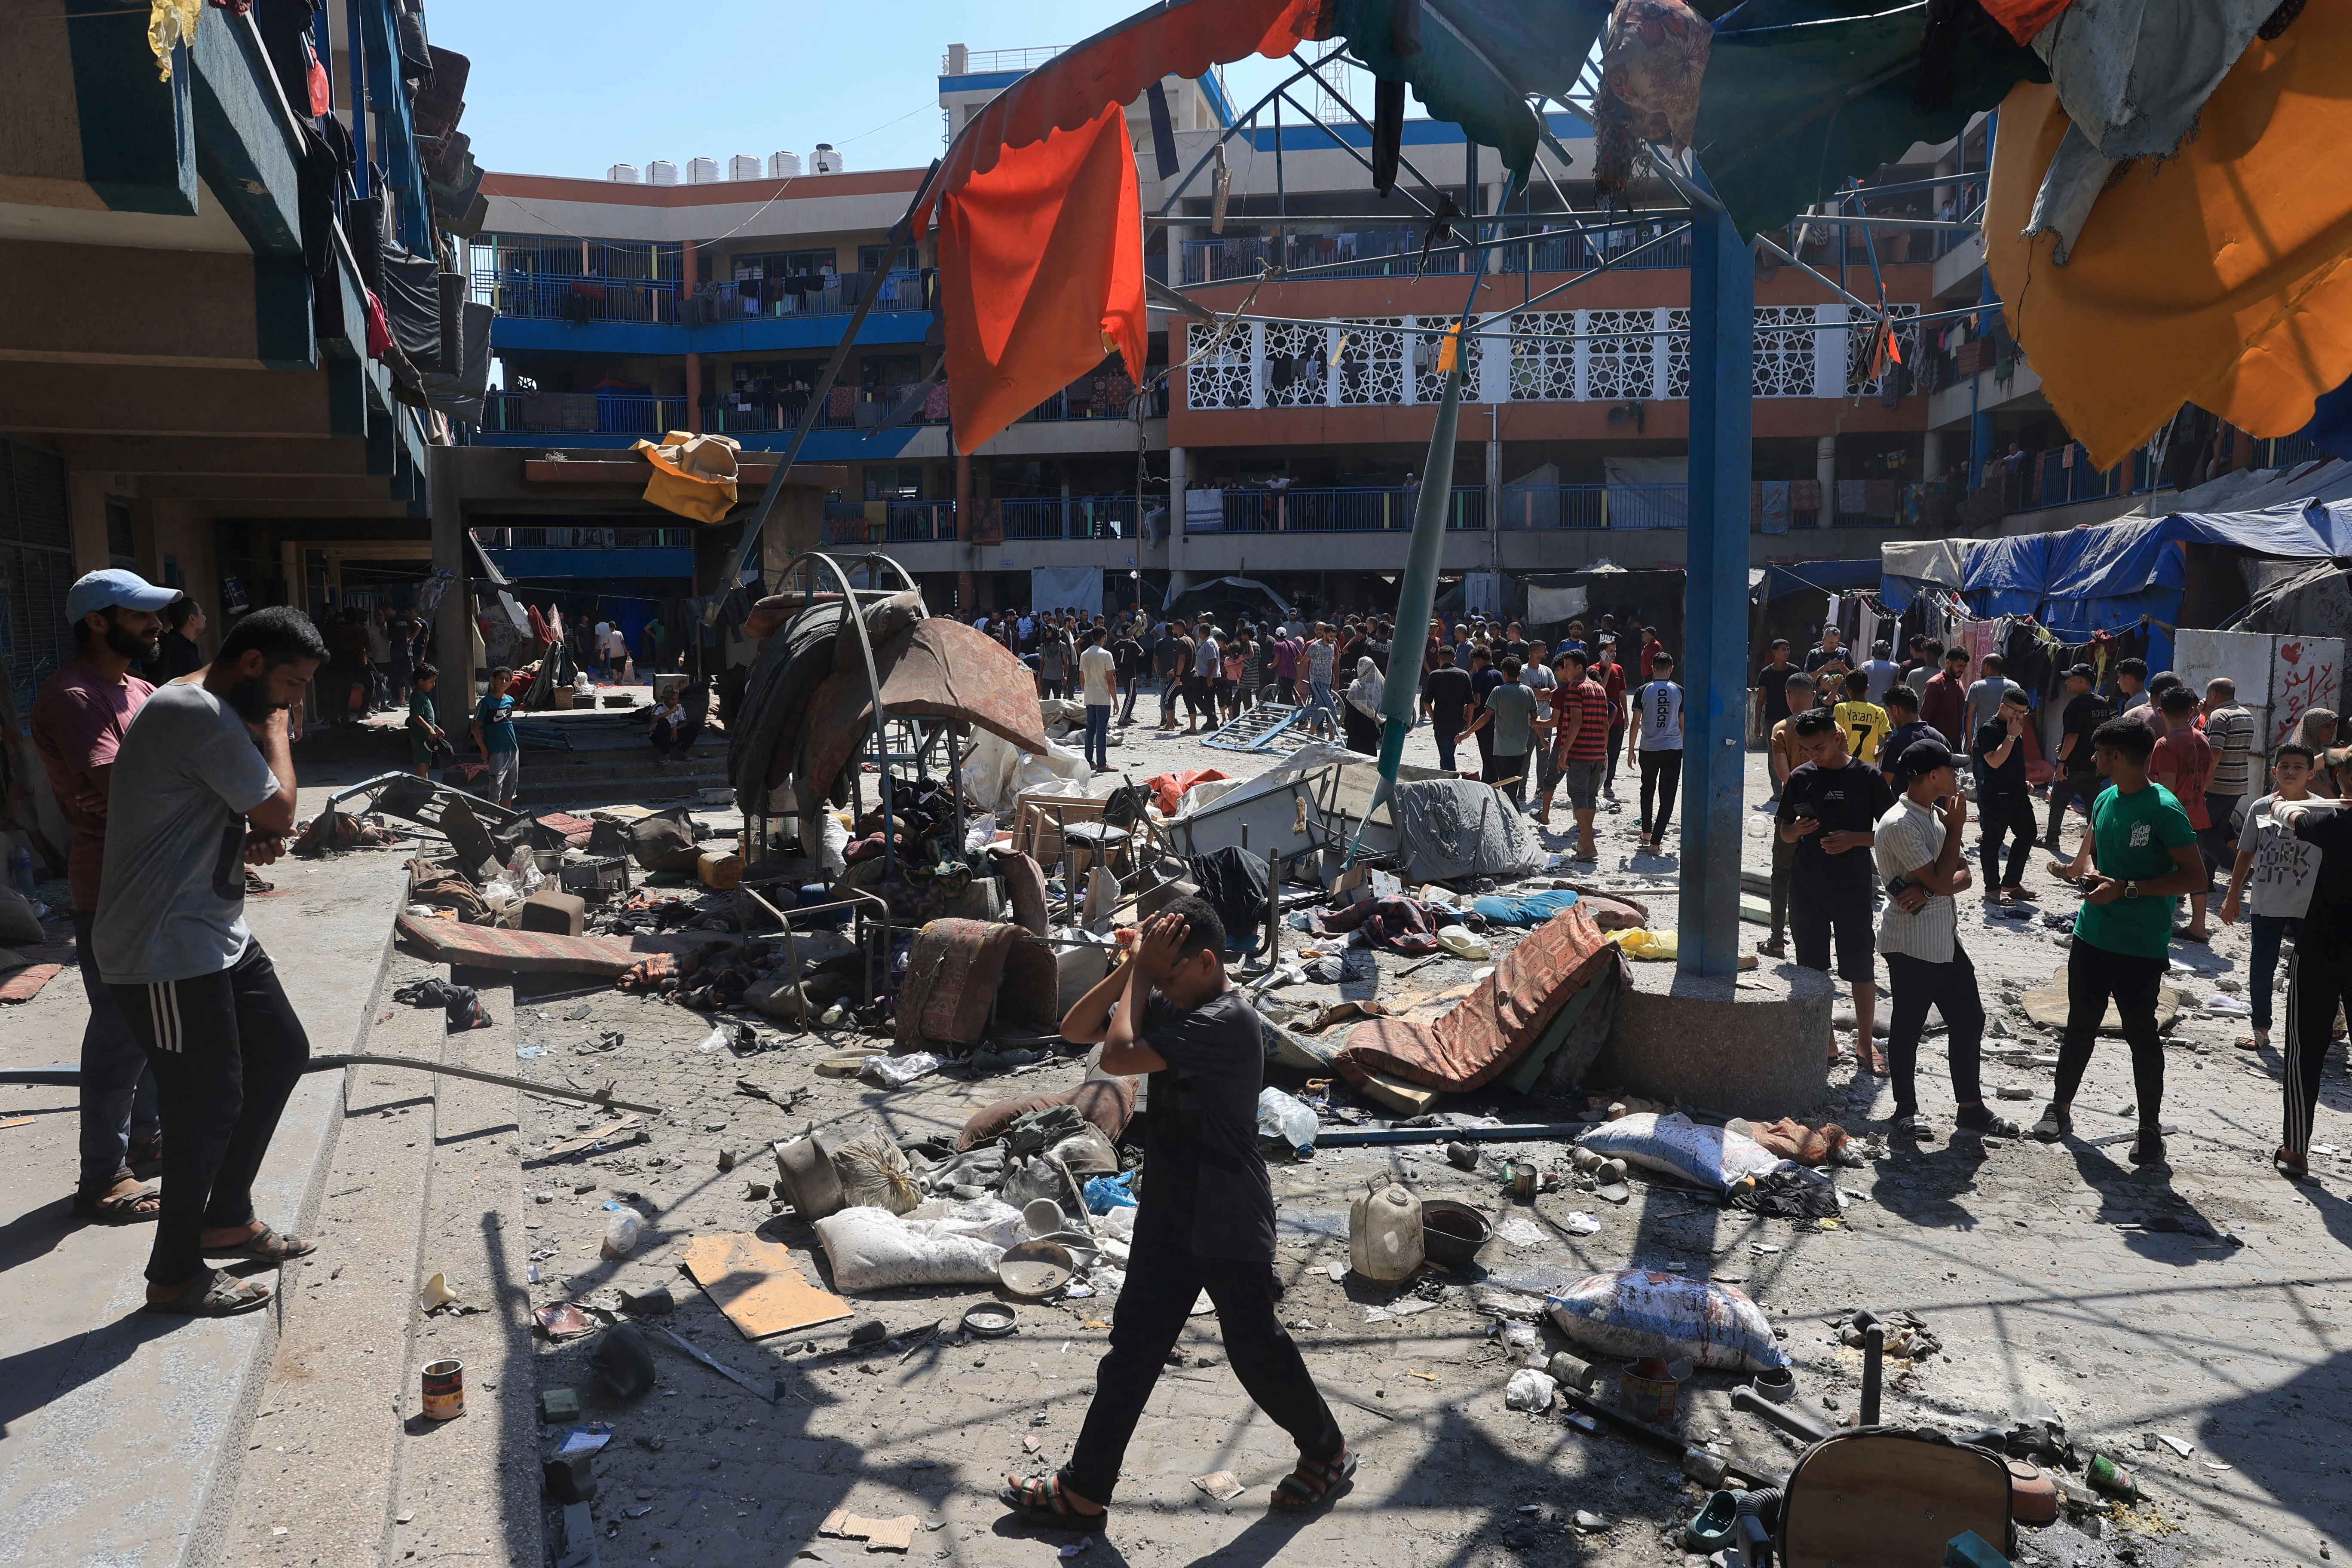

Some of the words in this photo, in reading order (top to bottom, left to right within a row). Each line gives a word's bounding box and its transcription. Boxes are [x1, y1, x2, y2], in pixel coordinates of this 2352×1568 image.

[1599, 633, 1616, 642] NIKE
[1120, 648, 1125, 663] 7
[1656, 689, 1670, 729] adidas
[1852, 723, 1873, 759] 7
[2259, 841, 2312, 867] YORK
[1896, 878, 1905, 887] nice
[2256, 864, 2309, 887] CITY
